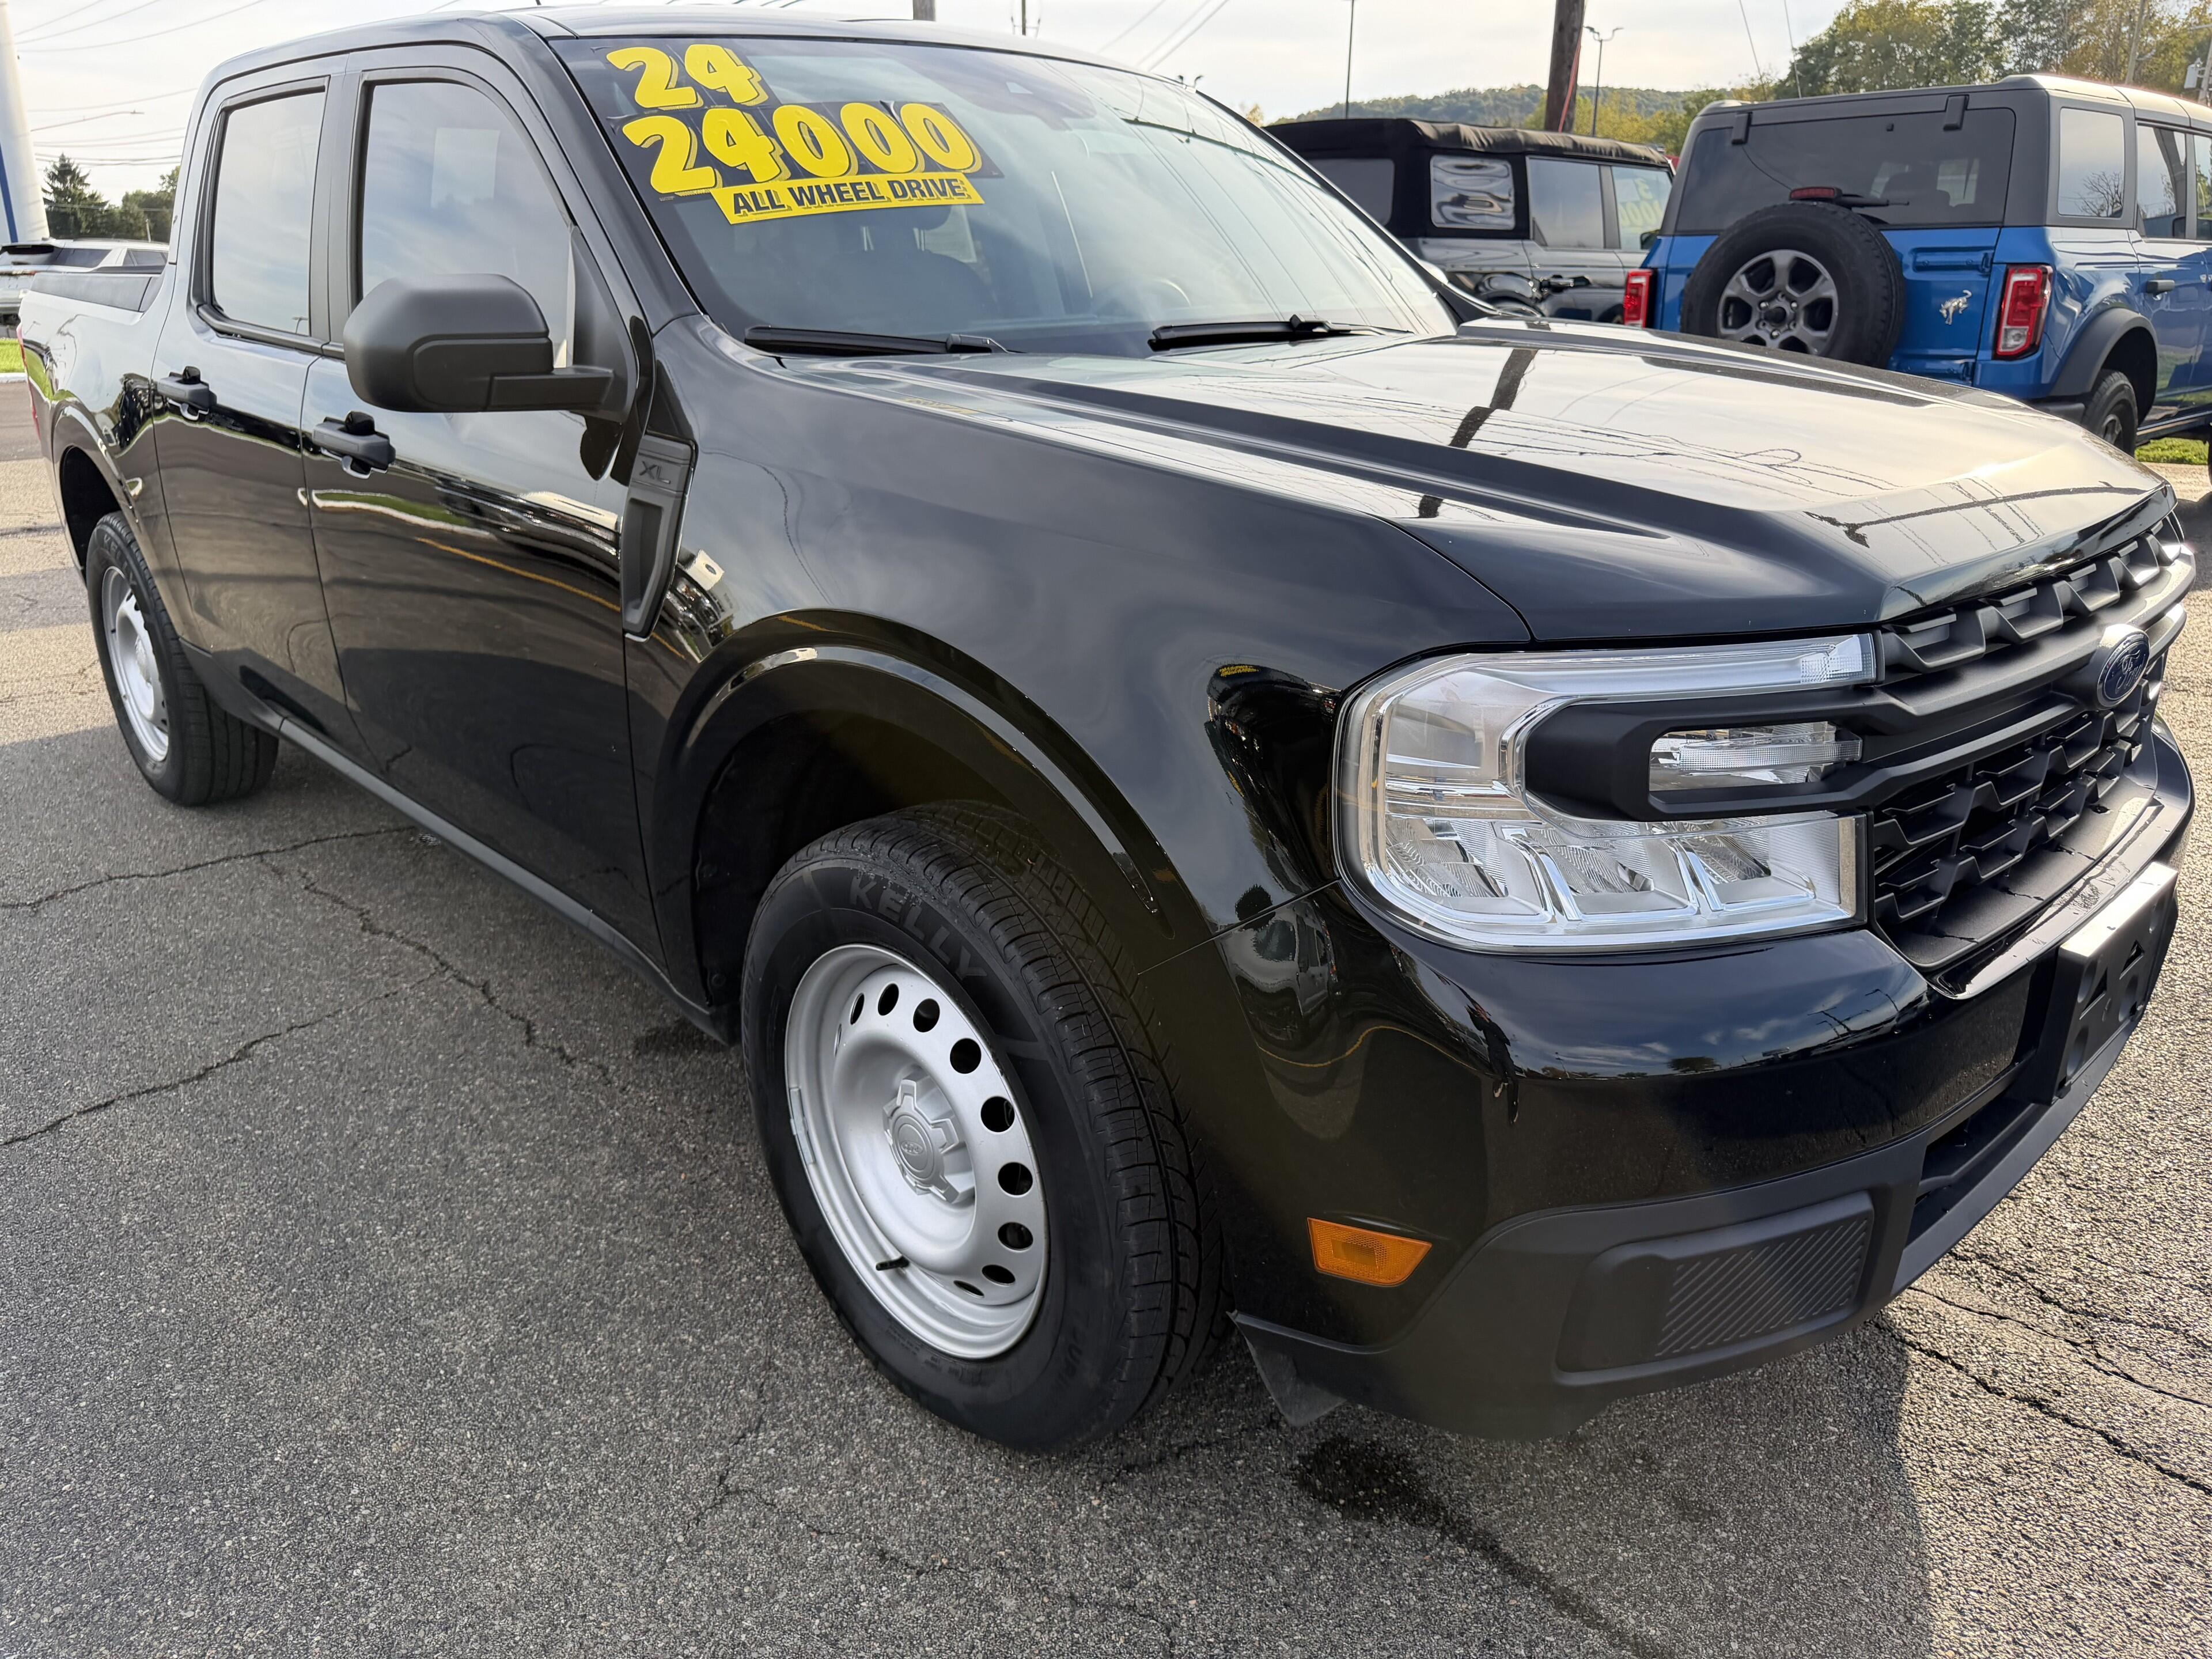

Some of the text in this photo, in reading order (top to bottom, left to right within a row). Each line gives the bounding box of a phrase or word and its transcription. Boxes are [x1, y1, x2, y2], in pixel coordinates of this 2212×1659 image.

[606, 44, 768, 110] 24
[622, 102, 981, 194] 24000
[733, 177, 967, 215] ALL WHEEL DRIVE
[639, 460, 671, 484] XL
[850, 871, 987, 980] KELLY
